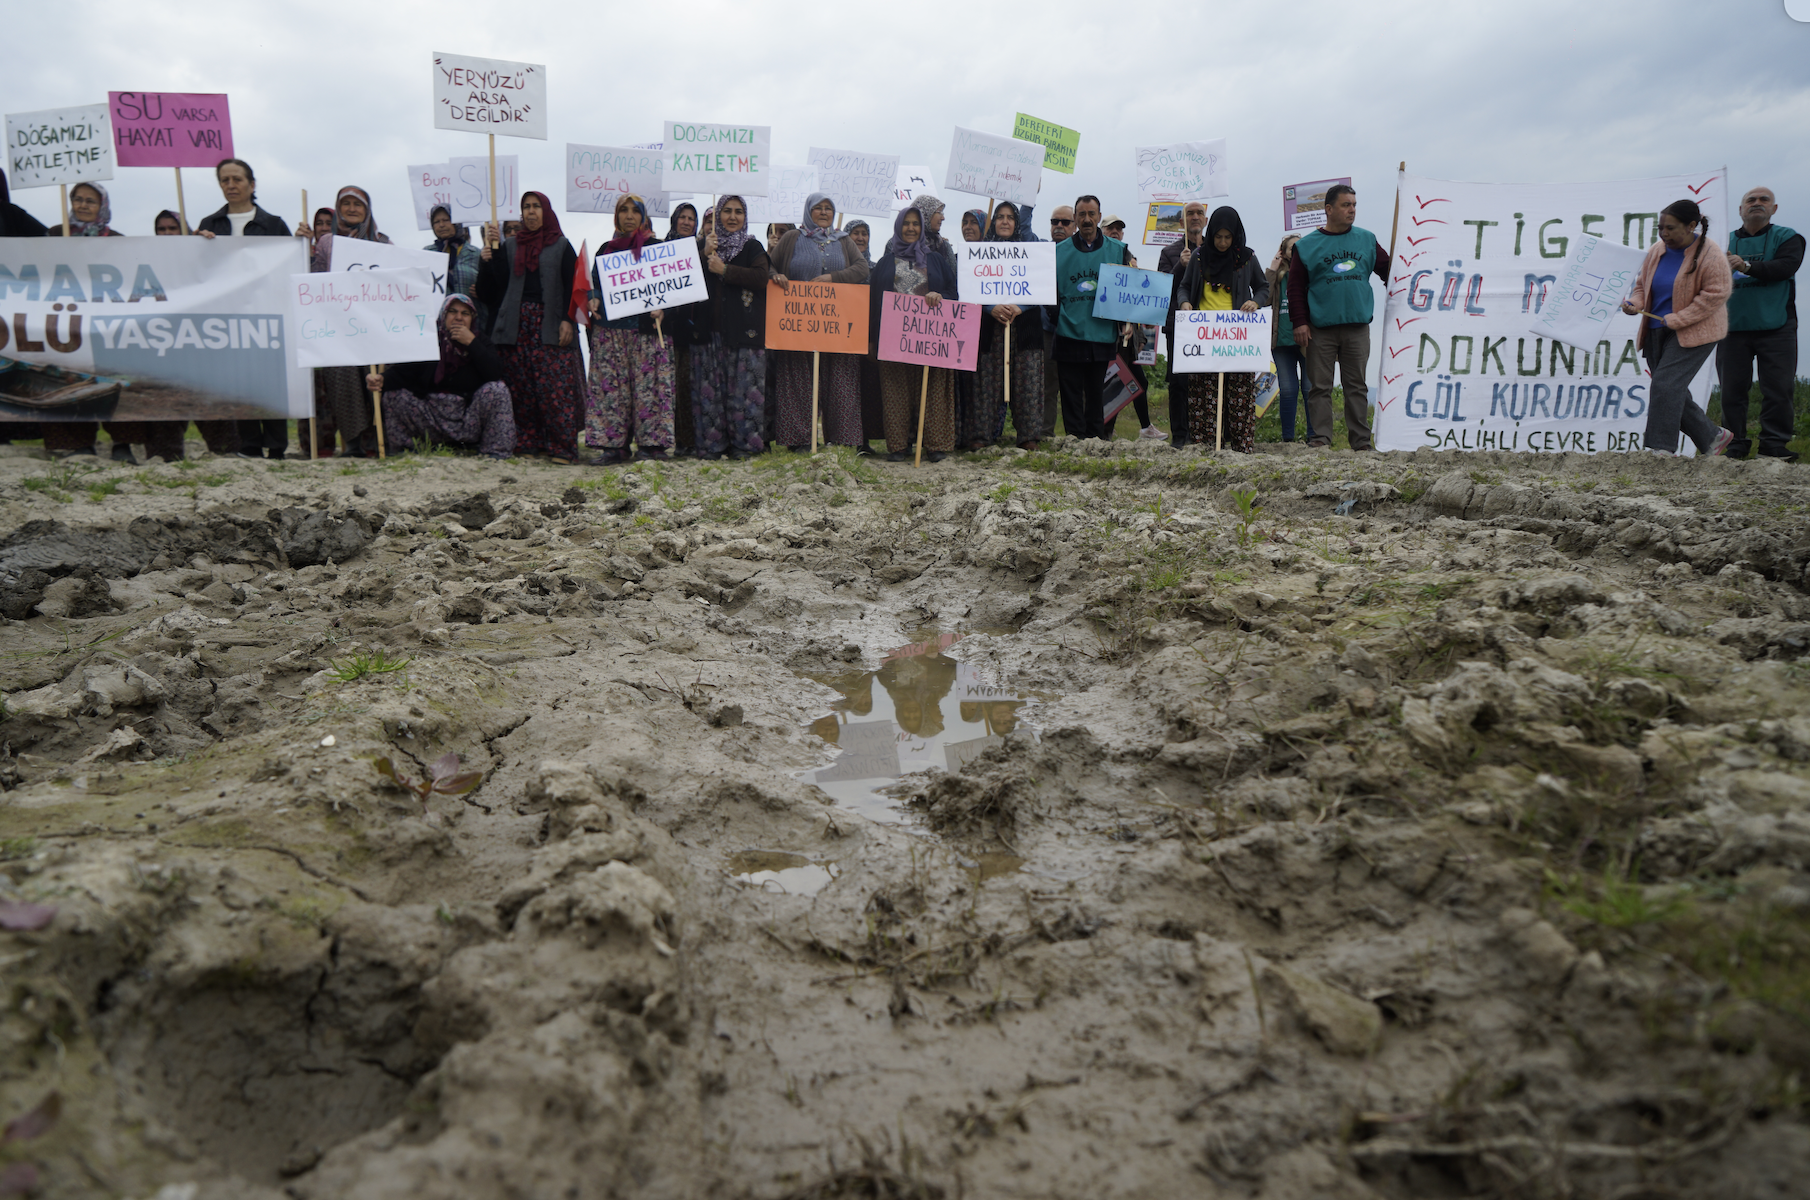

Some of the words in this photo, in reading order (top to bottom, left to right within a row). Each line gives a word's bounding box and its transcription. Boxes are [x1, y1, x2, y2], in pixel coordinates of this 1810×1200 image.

[117, 92, 163, 120] SU
[171, 108, 219, 122] VARSA
[467, 91, 510, 106] ARSA
[17, 122, 92, 147] DOĞAMIZI
[117, 127, 175, 148] HAYAT
[673, 124, 754, 143] DOĞAMIZI
[1019, 116, 1063, 139] DERELERİ
[956, 132, 1003, 157] Marmara
[1043, 138, 1076, 158] BIRAKIN
[14, 147, 100, 172] KATLETME
[571, 152, 664, 175] MARMARA
[672, 153, 759, 172] KATLETME
[1164, 165, 1192, 177] GERİ
[574, 175, 629, 193] GÖLÜ
[1463, 211, 1660, 260] TİGEM
[968, 247, 1029, 260] MARMARA
[1323, 249, 1363, 265] SALİHLİ
[608, 267, 646, 287] TERK
[650, 257, 693, 277] ETMEK
[1010, 264, 1026, 277] SU
[1069, 268, 1098, 284] SALİH
[1114, 272, 1128, 287] SU
[783, 284, 837, 299] BALIKÇIYA
[1406, 259, 1486, 316] GÖL
[1541, 261, 1584, 328] MARMARA
[1577, 236, 1598, 267] GÖLÜ
[298, 282, 359, 311] Balıkçıya
[361, 283, 395, 303] Kulak
[395, 283, 420, 302] Ver
[1587, 269, 1632, 323] İSTİYOR
[784, 300, 816, 316] KULAK
[820, 303, 840, 318] VER,
[893, 295, 944, 319] KUŞLAR
[952, 304, 967, 320] VE
[1215, 312, 1267, 324] MARMARA
[93, 318, 281, 356] YAŞASIN!
[301, 318, 336, 339] Göle
[345, 317, 368, 336] Su
[382, 317, 410, 333] Ver
[778, 318, 803, 333] GÖLE
[806, 320, 820, 334] SU
[823, 322, 841, 335] VER
[902, 317, 958, 340] BALIKLAR
[1197, 326, 1247, 341] OLMASIN
[900, 334, 950, 358] ÖLMESİN
[1211, 344, 1262, 356] MARMARA
[1416, 332, 1643, 378] DOKUNMA
[1405, 374, 1467, 422] GÖL
[1489, 382, 1647, 421] KURUMAS
[1423, 418, 1518, 452] SALİHLİ
[1527, 430, 1596, 452] ÇEVRE
